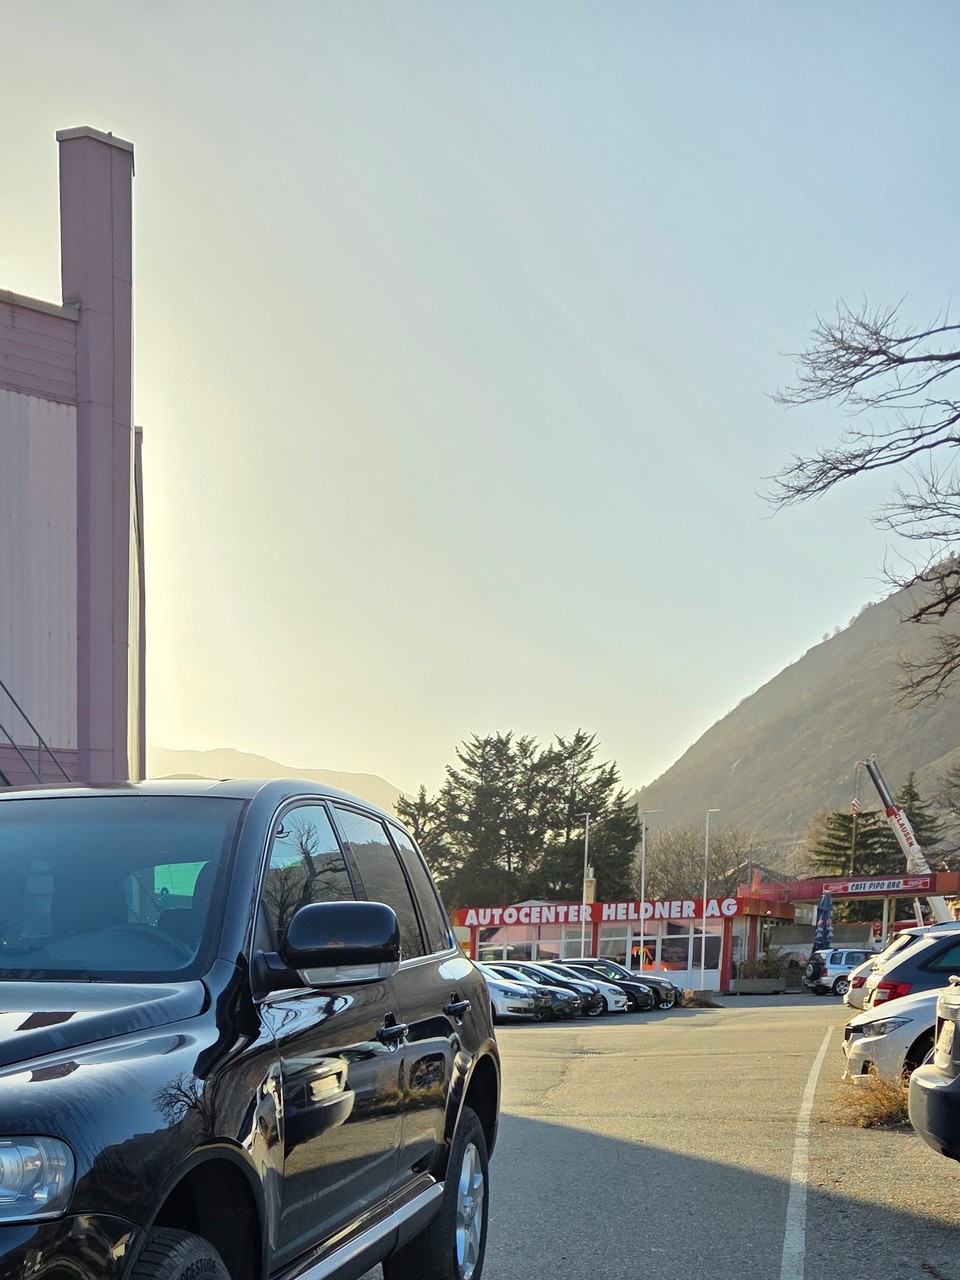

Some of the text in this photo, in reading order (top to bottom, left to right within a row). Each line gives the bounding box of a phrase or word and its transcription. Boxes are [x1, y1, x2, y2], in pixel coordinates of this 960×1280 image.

[894, 813, 914, 848] CLAUSEN
[869, 881, 885, 890] PIPO
[887, 880, 901, 889] BAR
[465, 898, 738, 926] AUTOCENTER HELDNER AG
